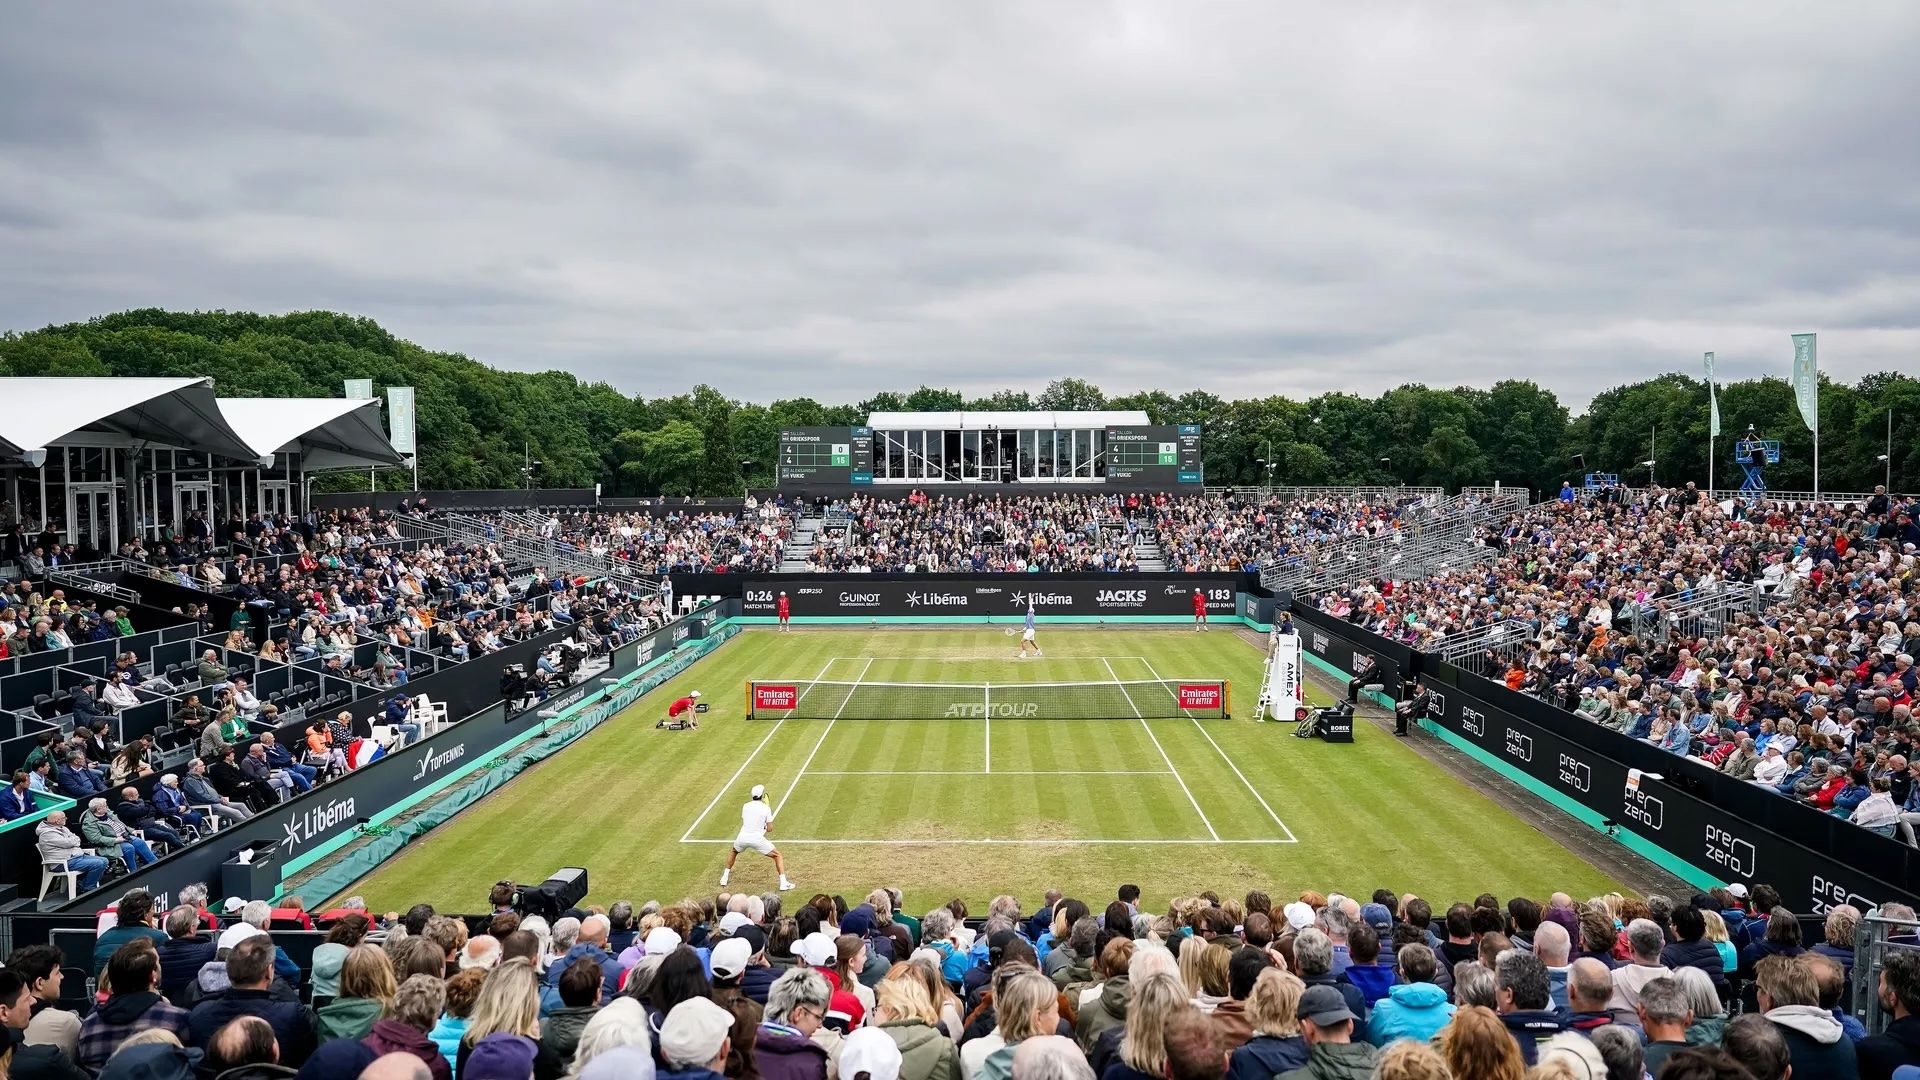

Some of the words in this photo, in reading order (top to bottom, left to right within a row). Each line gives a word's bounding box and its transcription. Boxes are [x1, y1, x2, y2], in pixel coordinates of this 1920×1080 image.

[1163, 455, 1173, 463] 15
[746, 590, 773, 602] 0:26
[839, 591, 881, 603] GUINOT
[923, 592, 968, 605] Libéma
[1095, 589, 1147, 602] JACKS
[1208, 589, 1230, 601] 183
[1286, 662, 1294, 697] AMEX
[757, 689, 794, 699] Emirates
[1181, 689, 1218, 698] Emirates
[944, 702, 985, 718] ATP
[989, 702, 1039, 717] TOUR
[1462, 705, 1475, 720] pre
[1462, 718, 1479, 735] zero
[1506, 727, 1520, 742] pre
[430, 743, 465, 772] TOPTENNIS
[1506, 741, 1525, 760] zero
[1559, 752, 1576, 770] pre
[1559, 768, 1582, 790] zero
[1624, 786, 1645, 804] pre
[304, 796, 355, 840] Libéma
[1624, 801, 1652, 826] zero
[1706, 824, 1732, 847] pre
[1705, 843, 1741, 873] zero
[1812, 875, 1846, 903] pre
[1811, 896, 1834, 915] ze
